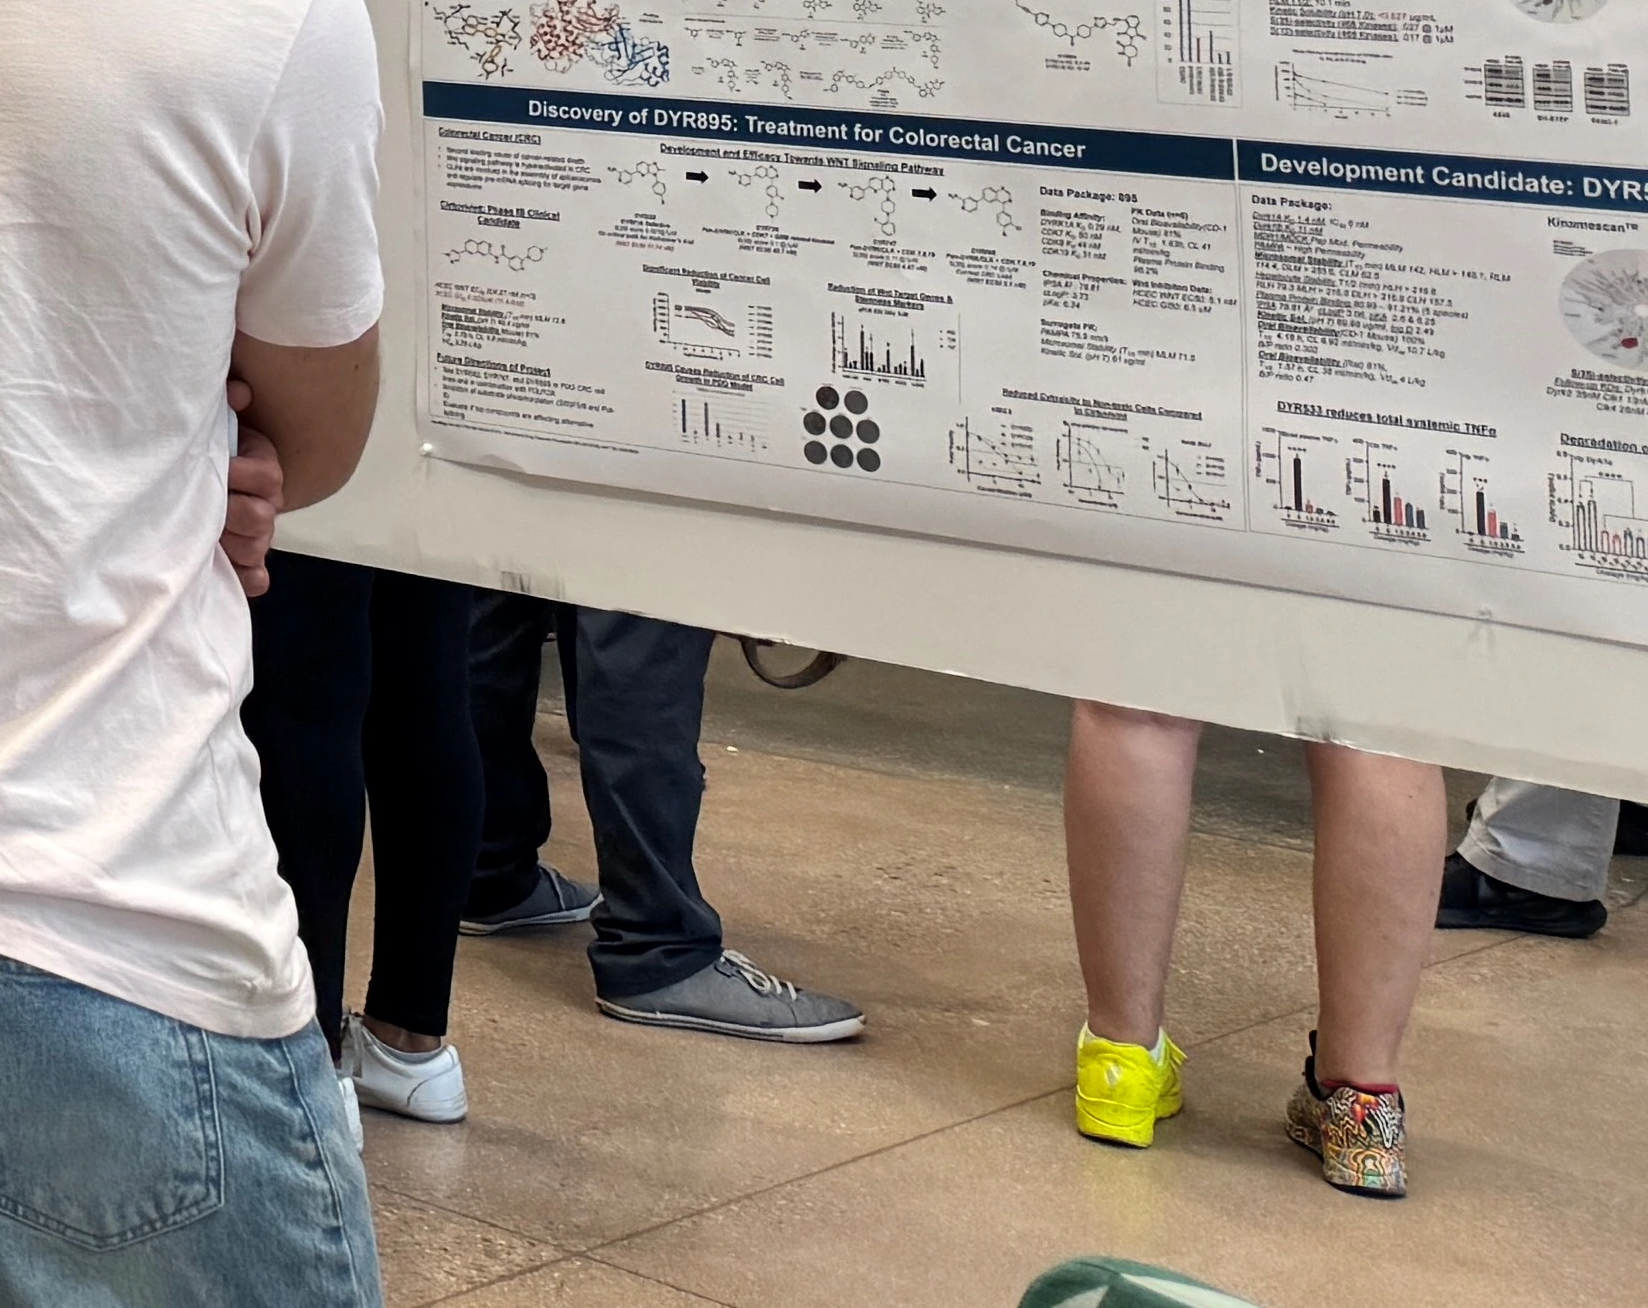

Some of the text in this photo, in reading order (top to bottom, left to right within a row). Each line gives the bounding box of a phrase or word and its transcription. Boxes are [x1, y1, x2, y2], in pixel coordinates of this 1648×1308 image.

[527, 100, 1086, 157] Discovery of DYR895: Treatment for Colorectal Cancer
[1261, 153, 1424, 183] Development
[1432, 166, 1573, 194] Candidate:
